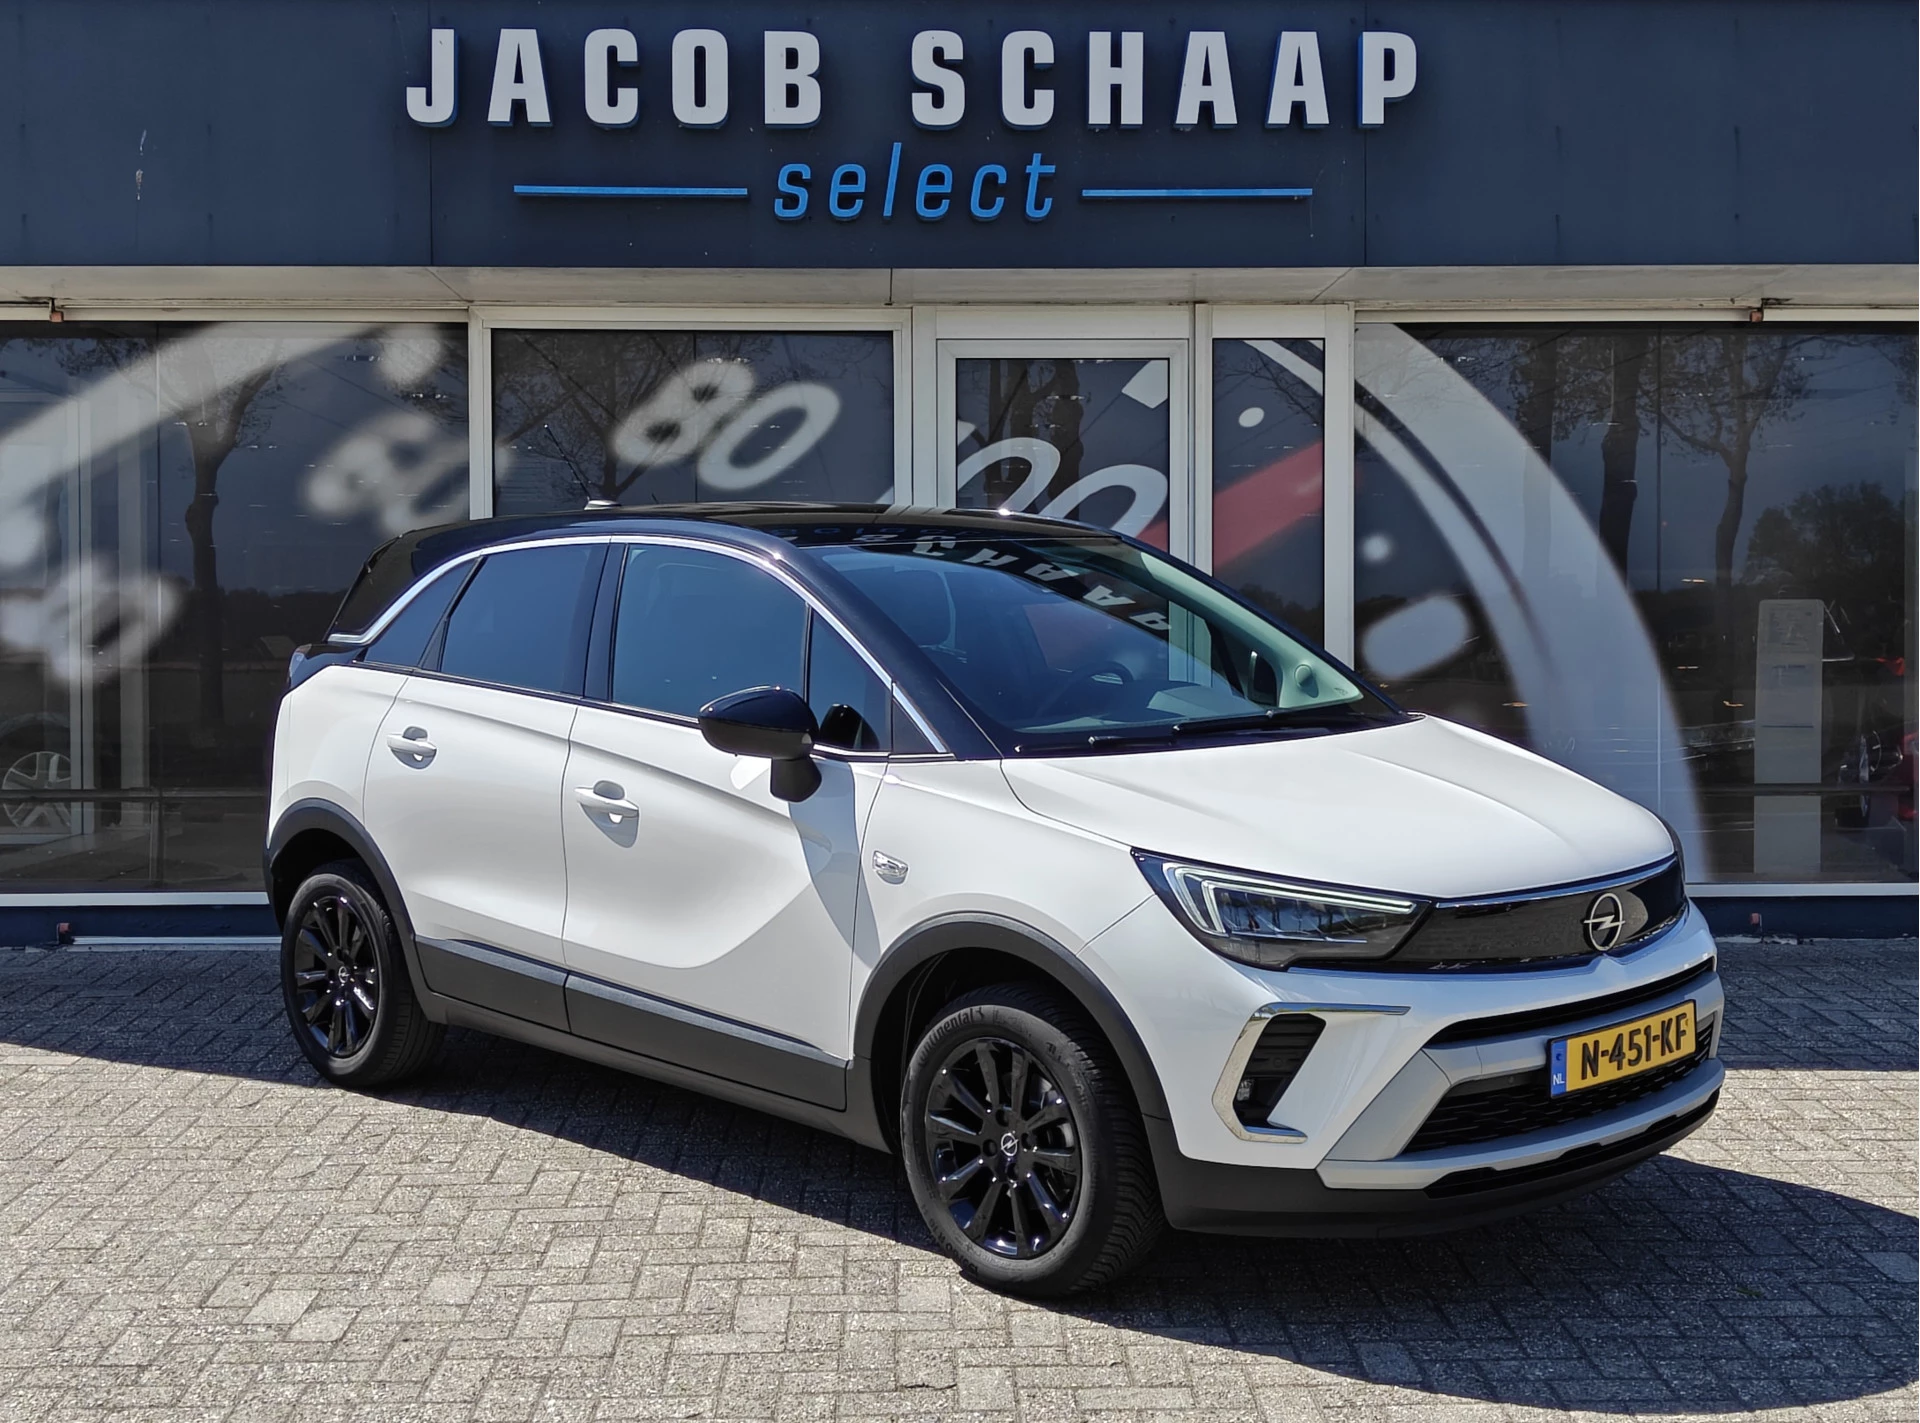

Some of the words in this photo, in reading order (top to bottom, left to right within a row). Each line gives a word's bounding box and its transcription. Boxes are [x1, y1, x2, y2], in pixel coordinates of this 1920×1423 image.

[406, 28, 823, 126] JACOB
[911, 29, 1418, 127] SCHAAP
[774, 142, 1056, 221] select
[613, 360, 840, 482] 80
[1552, 1073, 1566, 1085] NL
[1580, 1012, 1688, 1080] N-451-KF
